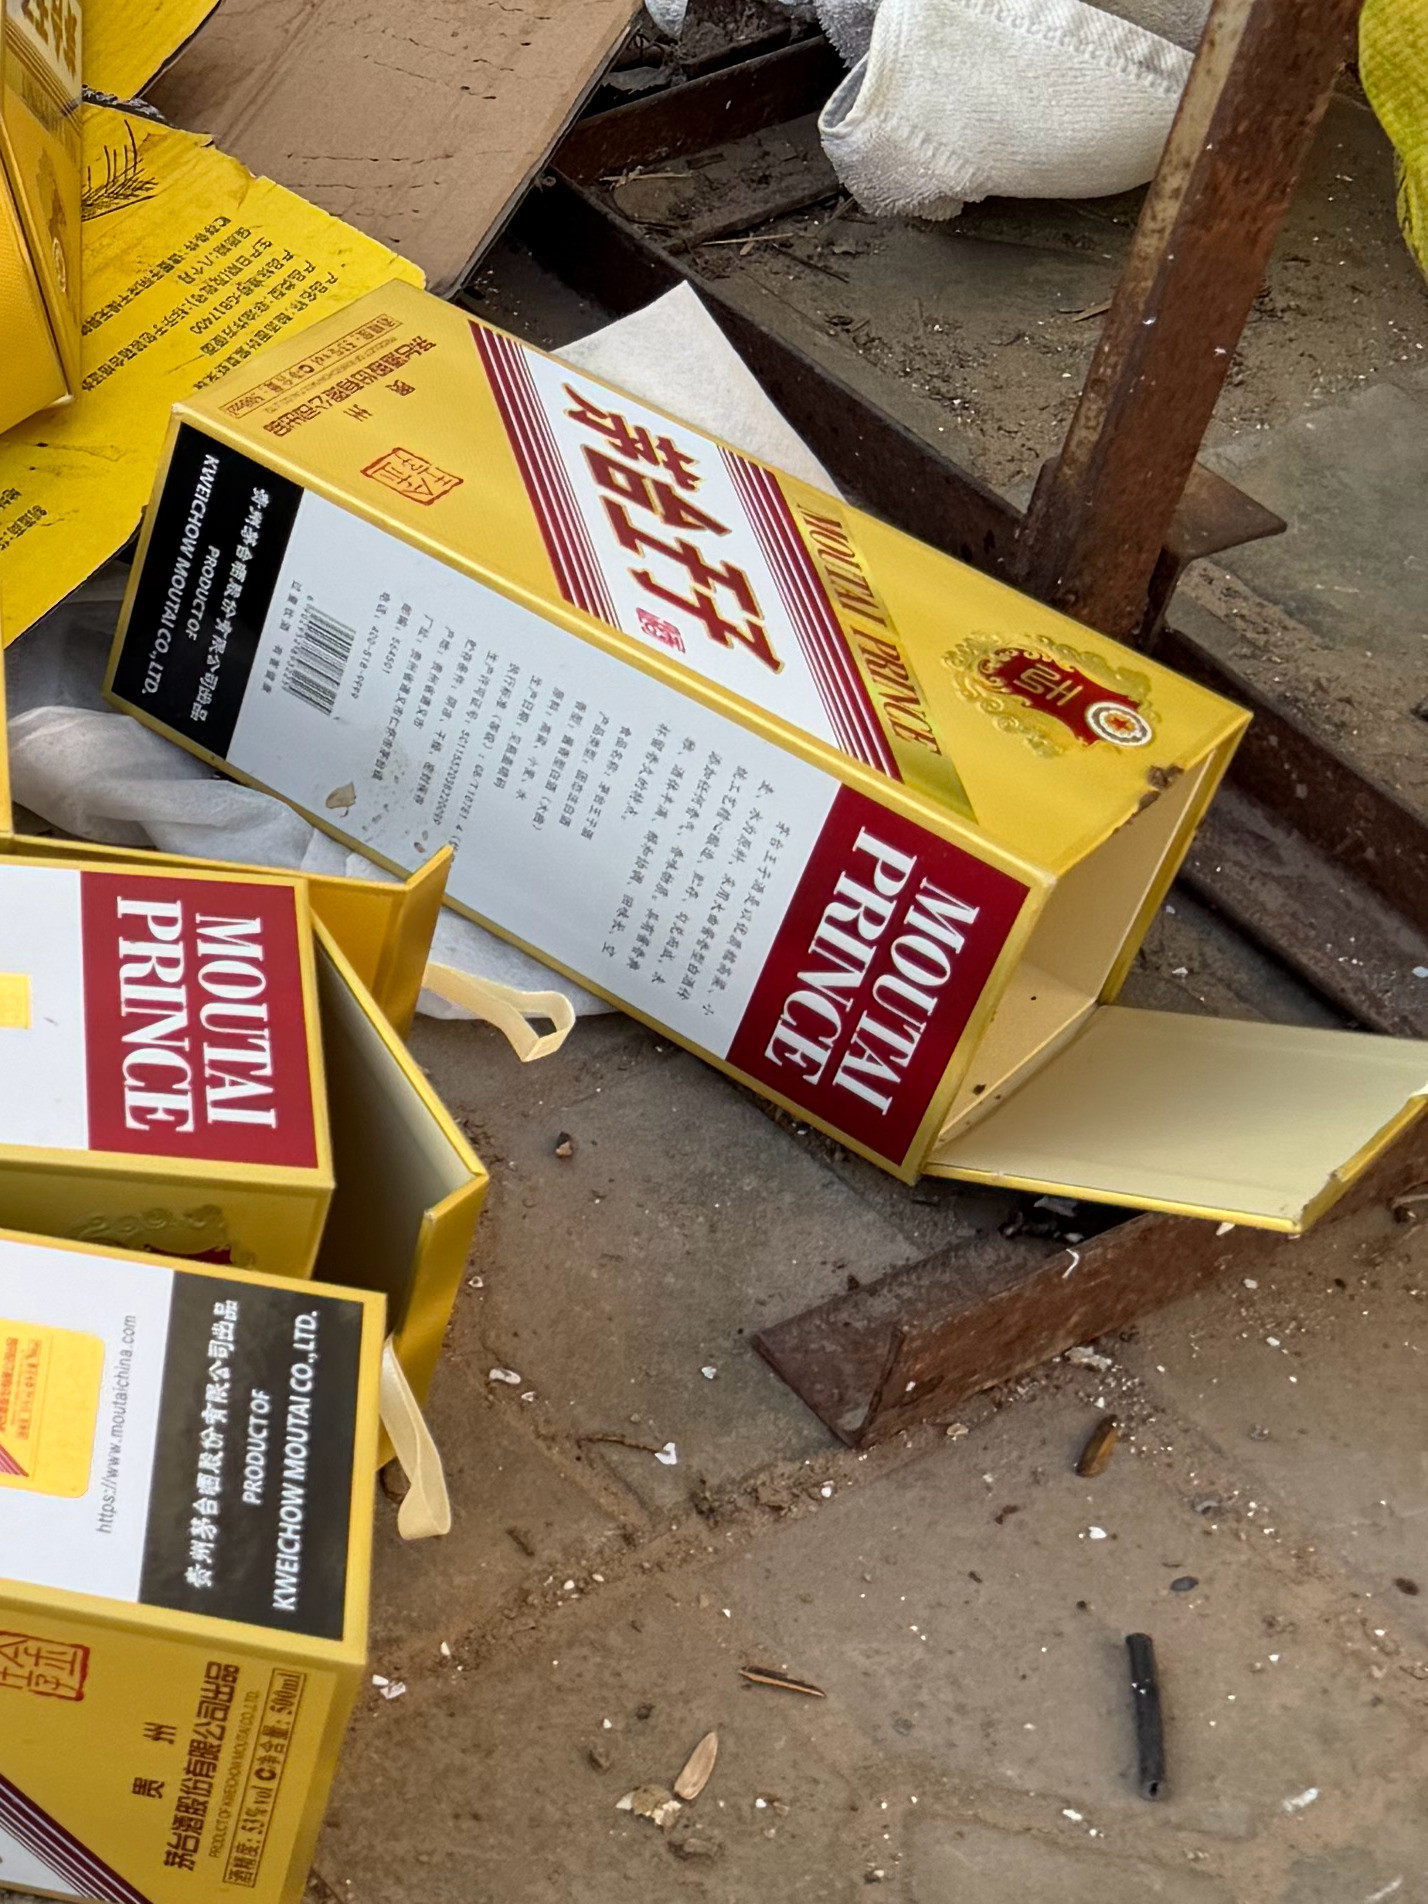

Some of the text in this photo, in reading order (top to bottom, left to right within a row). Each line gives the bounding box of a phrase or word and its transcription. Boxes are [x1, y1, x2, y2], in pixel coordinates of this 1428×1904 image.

[262, 335, 437, 438] 茅台酒股份有限公司出品
[160, 556, 192, 628] MOUTAI
[180, 454, 220, 559] KWEICHOW
[185, 545, 220, 641] PRODUCT OF
[564, 384, 779, 672] 茅台王子
[796, 503, 942, 756] MOUTAI PRINCE
[116, 895, 193, 1132] PRINCE
[195, 912, 274, 1129] MOUTAI
[764, 826, 918, 1085] PRINCE
[832, 876, 980, 1116] MOUTAI
[95, 1314, 136, 1534] https://www.moutaichina.com
[184, 1299, 238, 1588] 贵州茅台酒股份有限公司出品
[239, 1387, 275, 1506] PRODUCT OF
[282, 1395, 311, 1481] MOUTAI
[272, 1482, 305, 1611] KWEICHOW
[161, 1658, 242, 1872] 茅台酒股份有限公司出品
